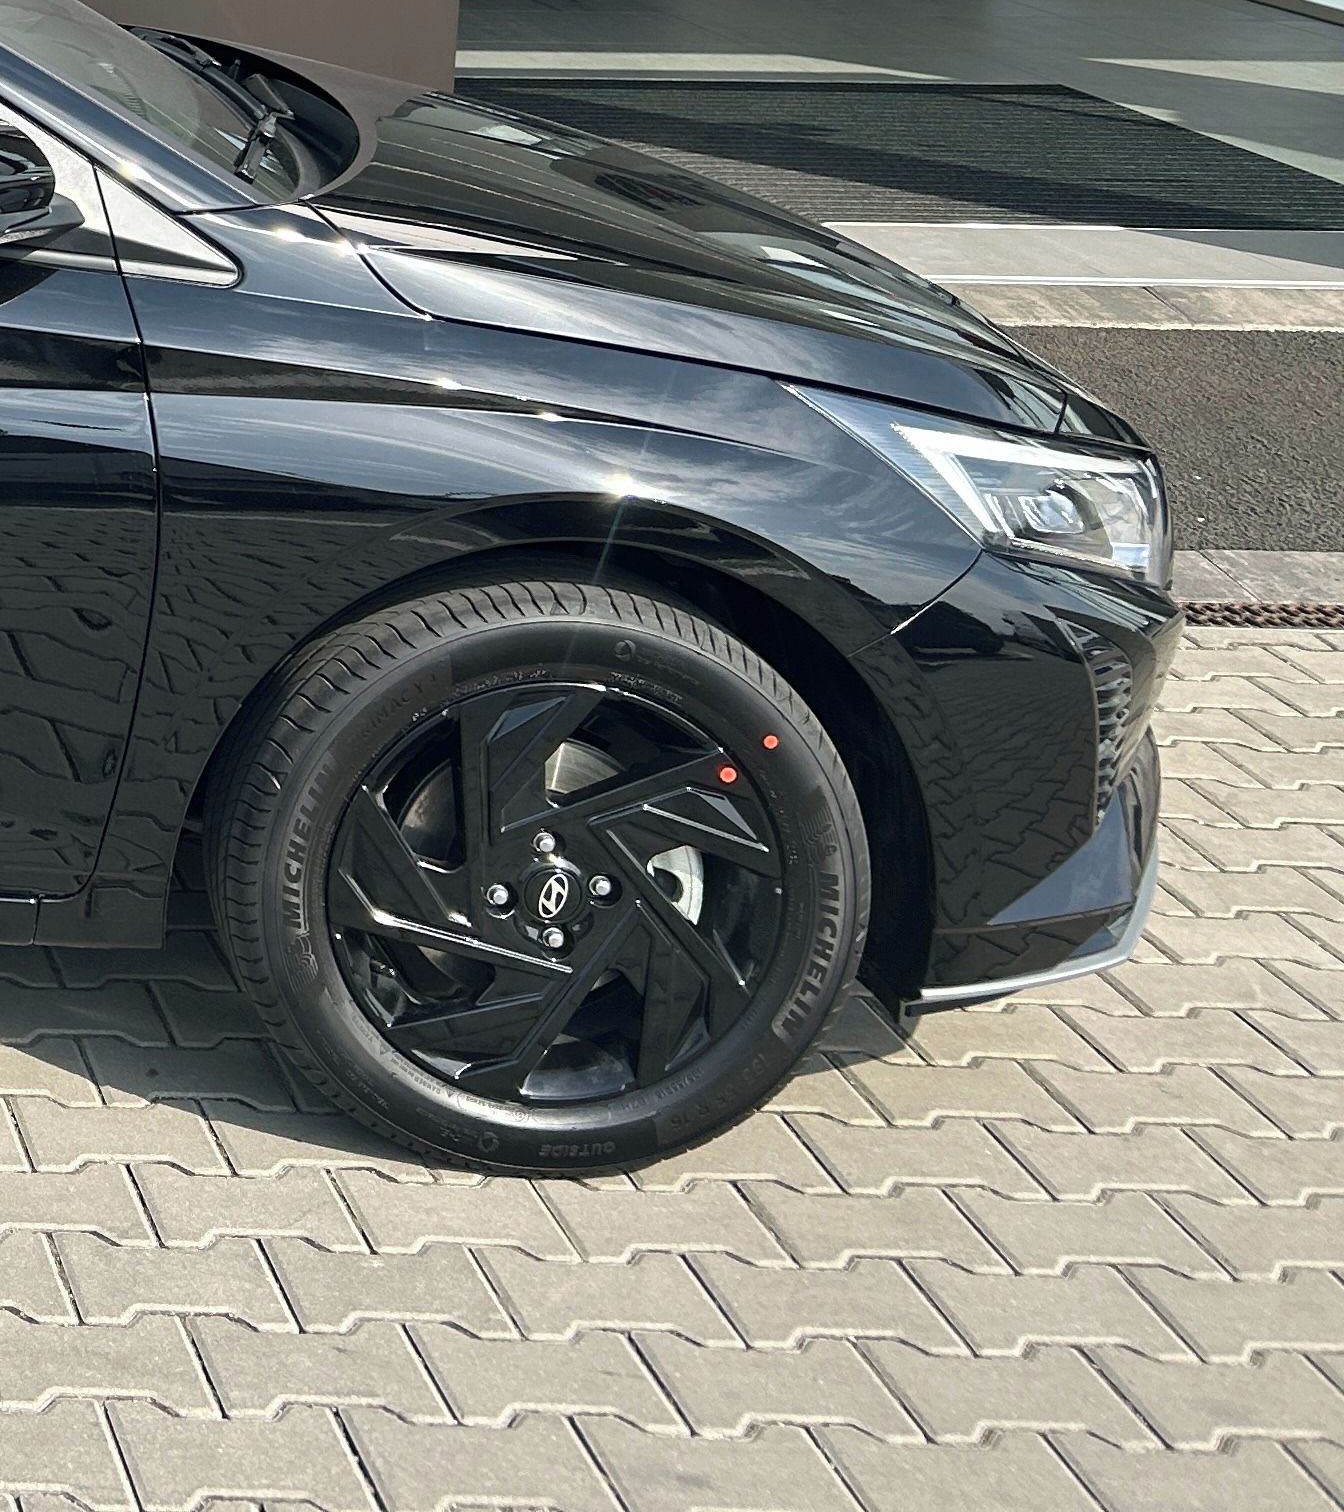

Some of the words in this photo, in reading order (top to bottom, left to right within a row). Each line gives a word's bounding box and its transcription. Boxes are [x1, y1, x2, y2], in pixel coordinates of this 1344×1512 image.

[282, 762, 338, 932] MICHELIN
[778, 870, 840, 1038] MICHELIN
[537, 1139, 616, 1157] OUTSIDE
